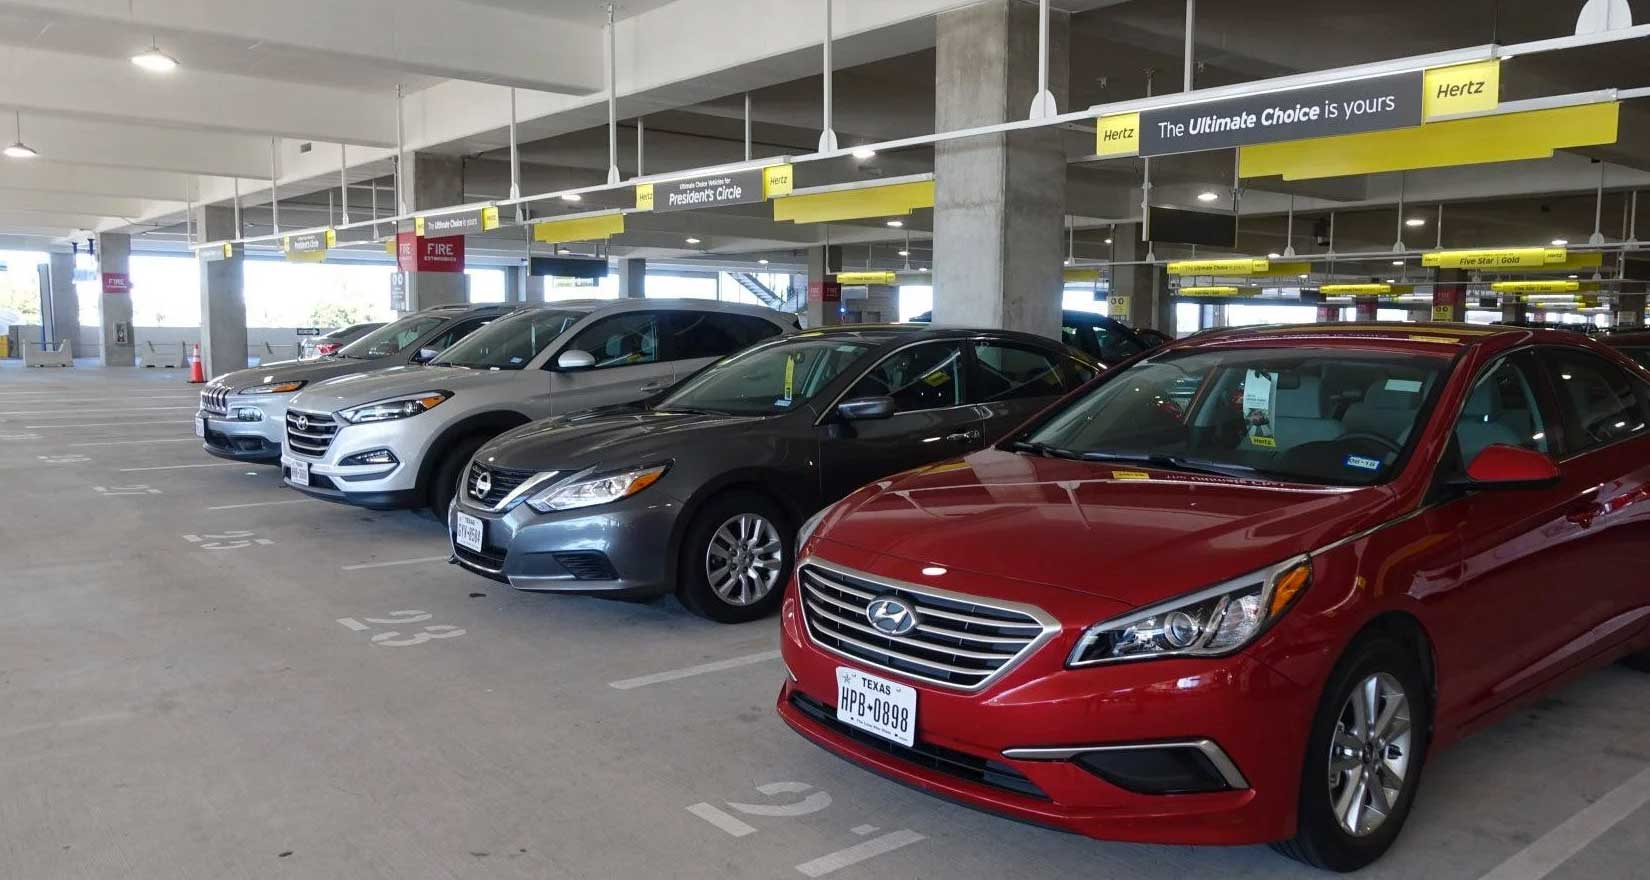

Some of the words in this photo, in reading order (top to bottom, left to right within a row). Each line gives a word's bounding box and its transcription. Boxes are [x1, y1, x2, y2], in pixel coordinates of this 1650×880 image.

[1436, 78, 1485, 100] Hertz
[1158, 121, 1185, 139] The
[1188, 110, 1257, 135] Ultimate
[1260, 103, 1321, 126] Choice
[1324, 100, 1339, 120] is
[1343, 94, 1396, 121] yours
[1103, 125, 1134, 142] Hertz
[770, 175, 788, 186] Hertz
[669, 189, 714, 206] President's
[716, 186, 742, 200] Circle
[427, 243, 454, 255] FIRE
[1460, 257, 1476, 265] Five
[1478, 256, 1494, 265] Star
[1501, 255, 1520, 264] Gold
[335, 609, 468, 648] 23
[861, 676, 892, 696] TEXAS
